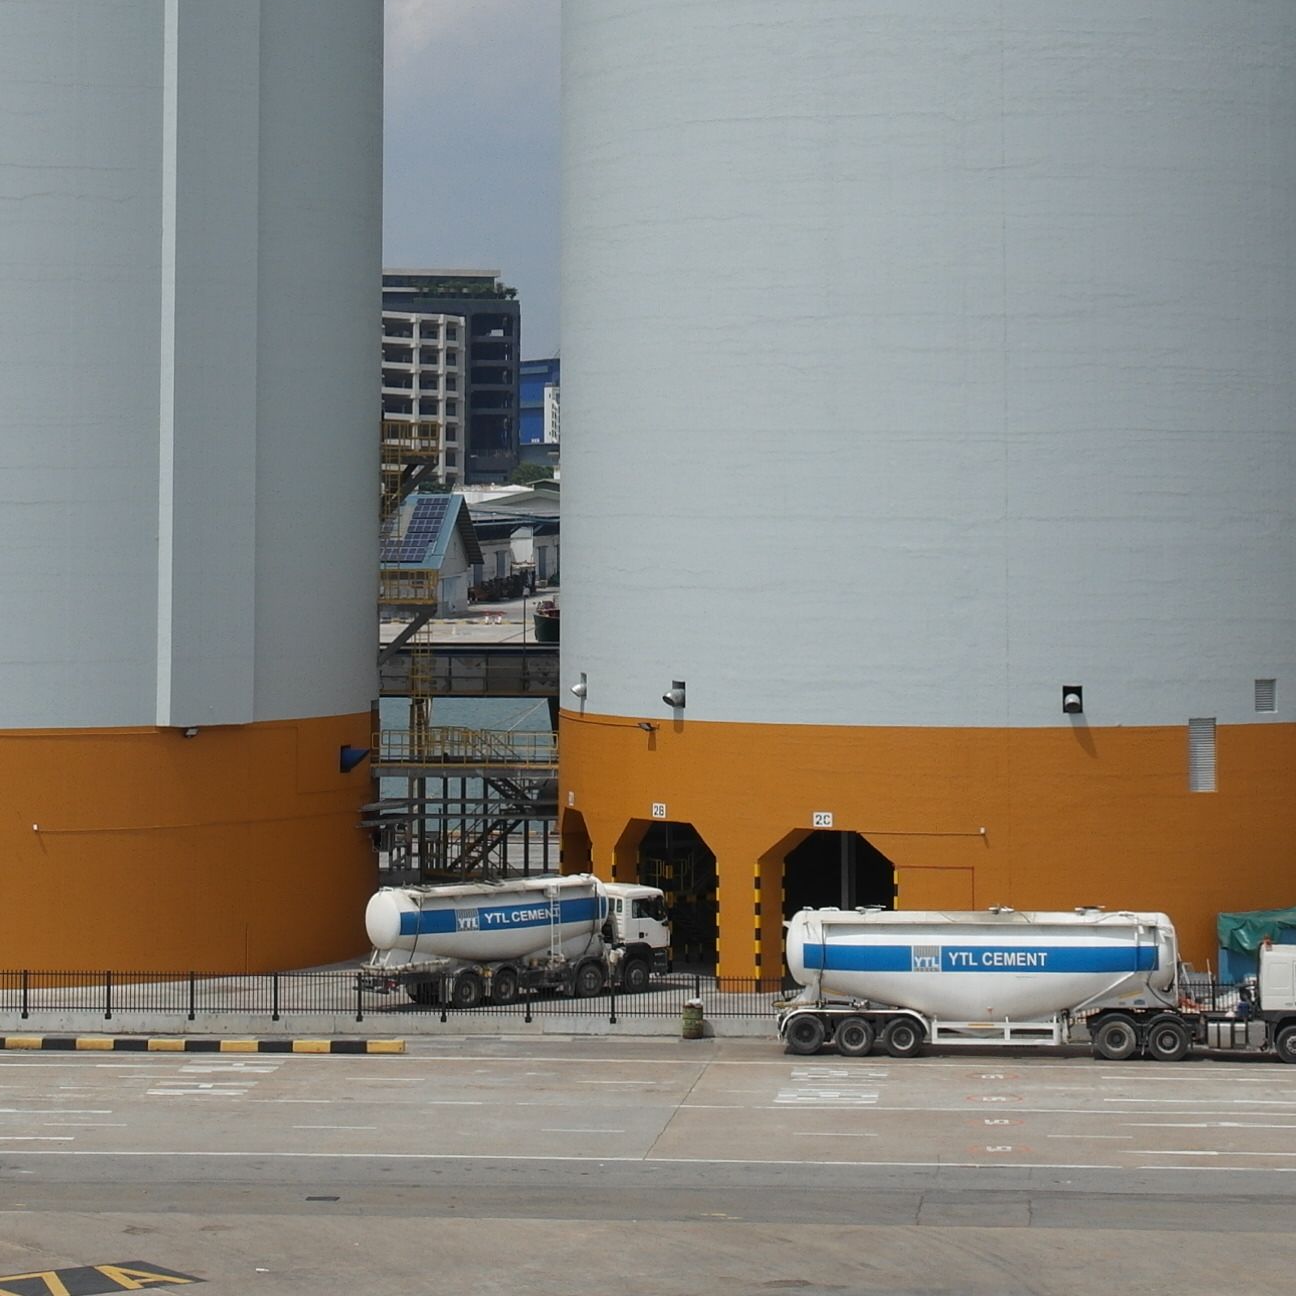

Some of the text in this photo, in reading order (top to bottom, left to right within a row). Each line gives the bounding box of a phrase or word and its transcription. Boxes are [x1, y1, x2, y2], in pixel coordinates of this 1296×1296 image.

[815, 814, 830, 825] 2C
[458, 917, 478, 929] YTL
[484, 912, 510, 924] YTL
[914, 956, 939, 968] YTL
[948, 951, 1047, 966] YTL CEMENT
